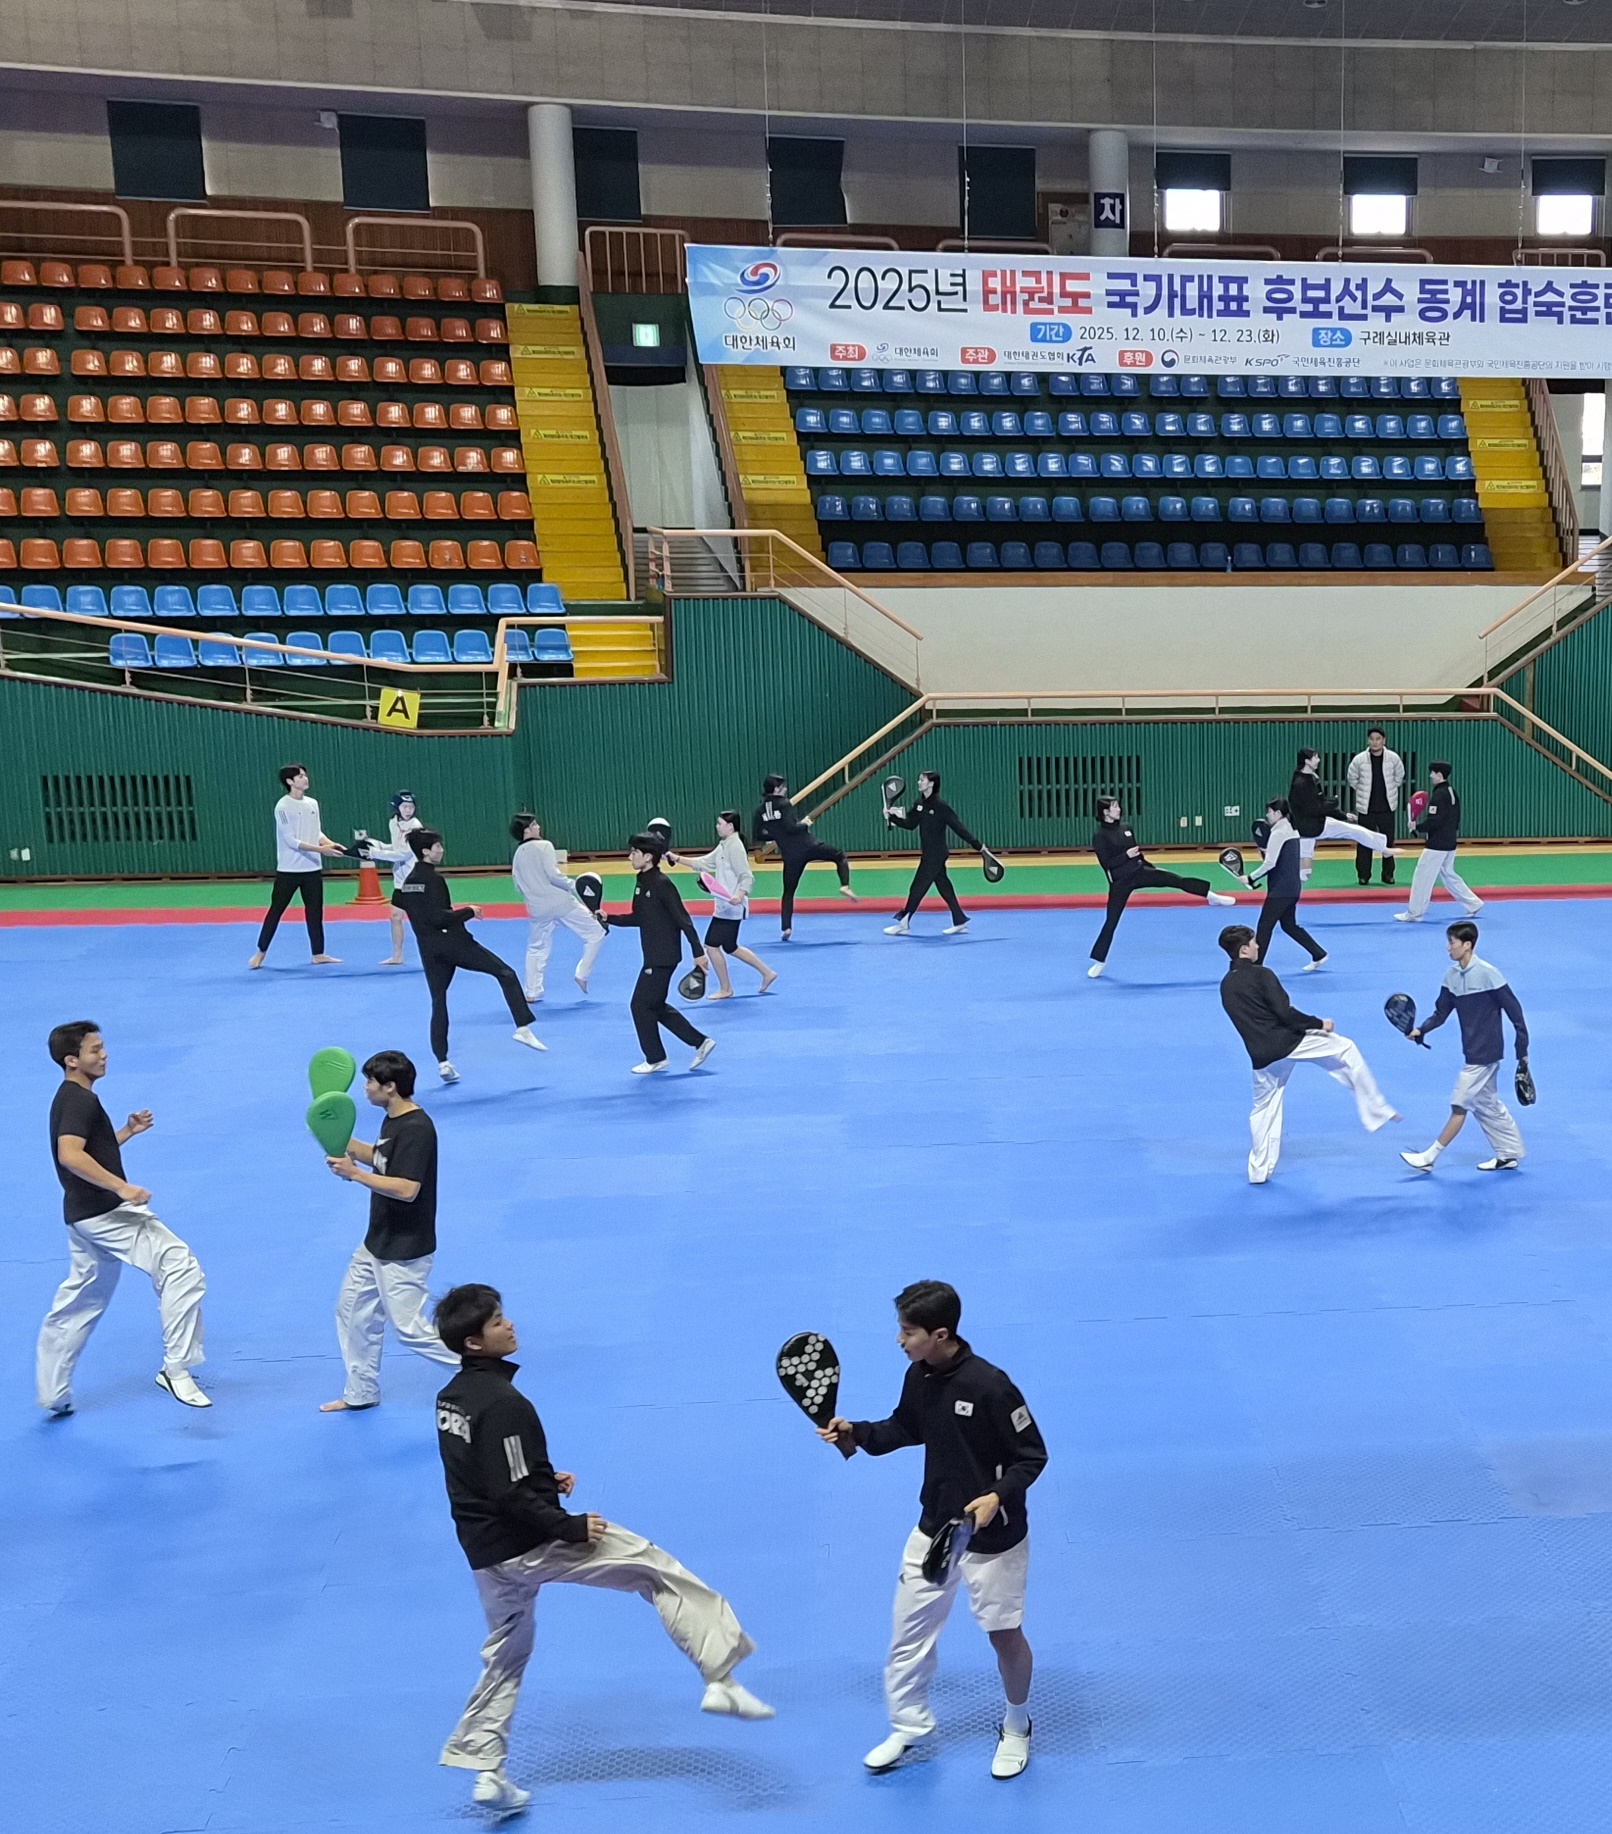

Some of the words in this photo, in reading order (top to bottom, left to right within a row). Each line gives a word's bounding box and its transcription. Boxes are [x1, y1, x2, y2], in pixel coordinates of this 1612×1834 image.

[1099, 196, 1122, 224] 차
[827, 265, 968, 314] 2025년
[980, 268, 1093, 317] 태권도
[1105, 271, 1251, 319] 국가대표
[1263, 275, 1406, 323] 후보선수
[1416, 279, 1489, 324] 동계
[1036, 325, 1065, 342] 기간
[1079, 326, 1117, 341] 2025.
[1124, 326, 1144, 342] 12.
[1150, 327, 1193, 343] 10.(수)
[1212, 328, 1231, 343] 12.
[1236, 328, 1280, 344] 23.(화)
[1318, 329, 1346, 346] 장소
[724, 334, 796, 351] 대한체육회
[835, 345, 859, 360] 주최
[965, 348, 990, 363] 주관
[1067, 346, 1097, 367] KTA
[1123, 350, 1147, 366] 후원
[1245, 356, 1279, 367] KSPO
[385, 689, 411, 720] A
